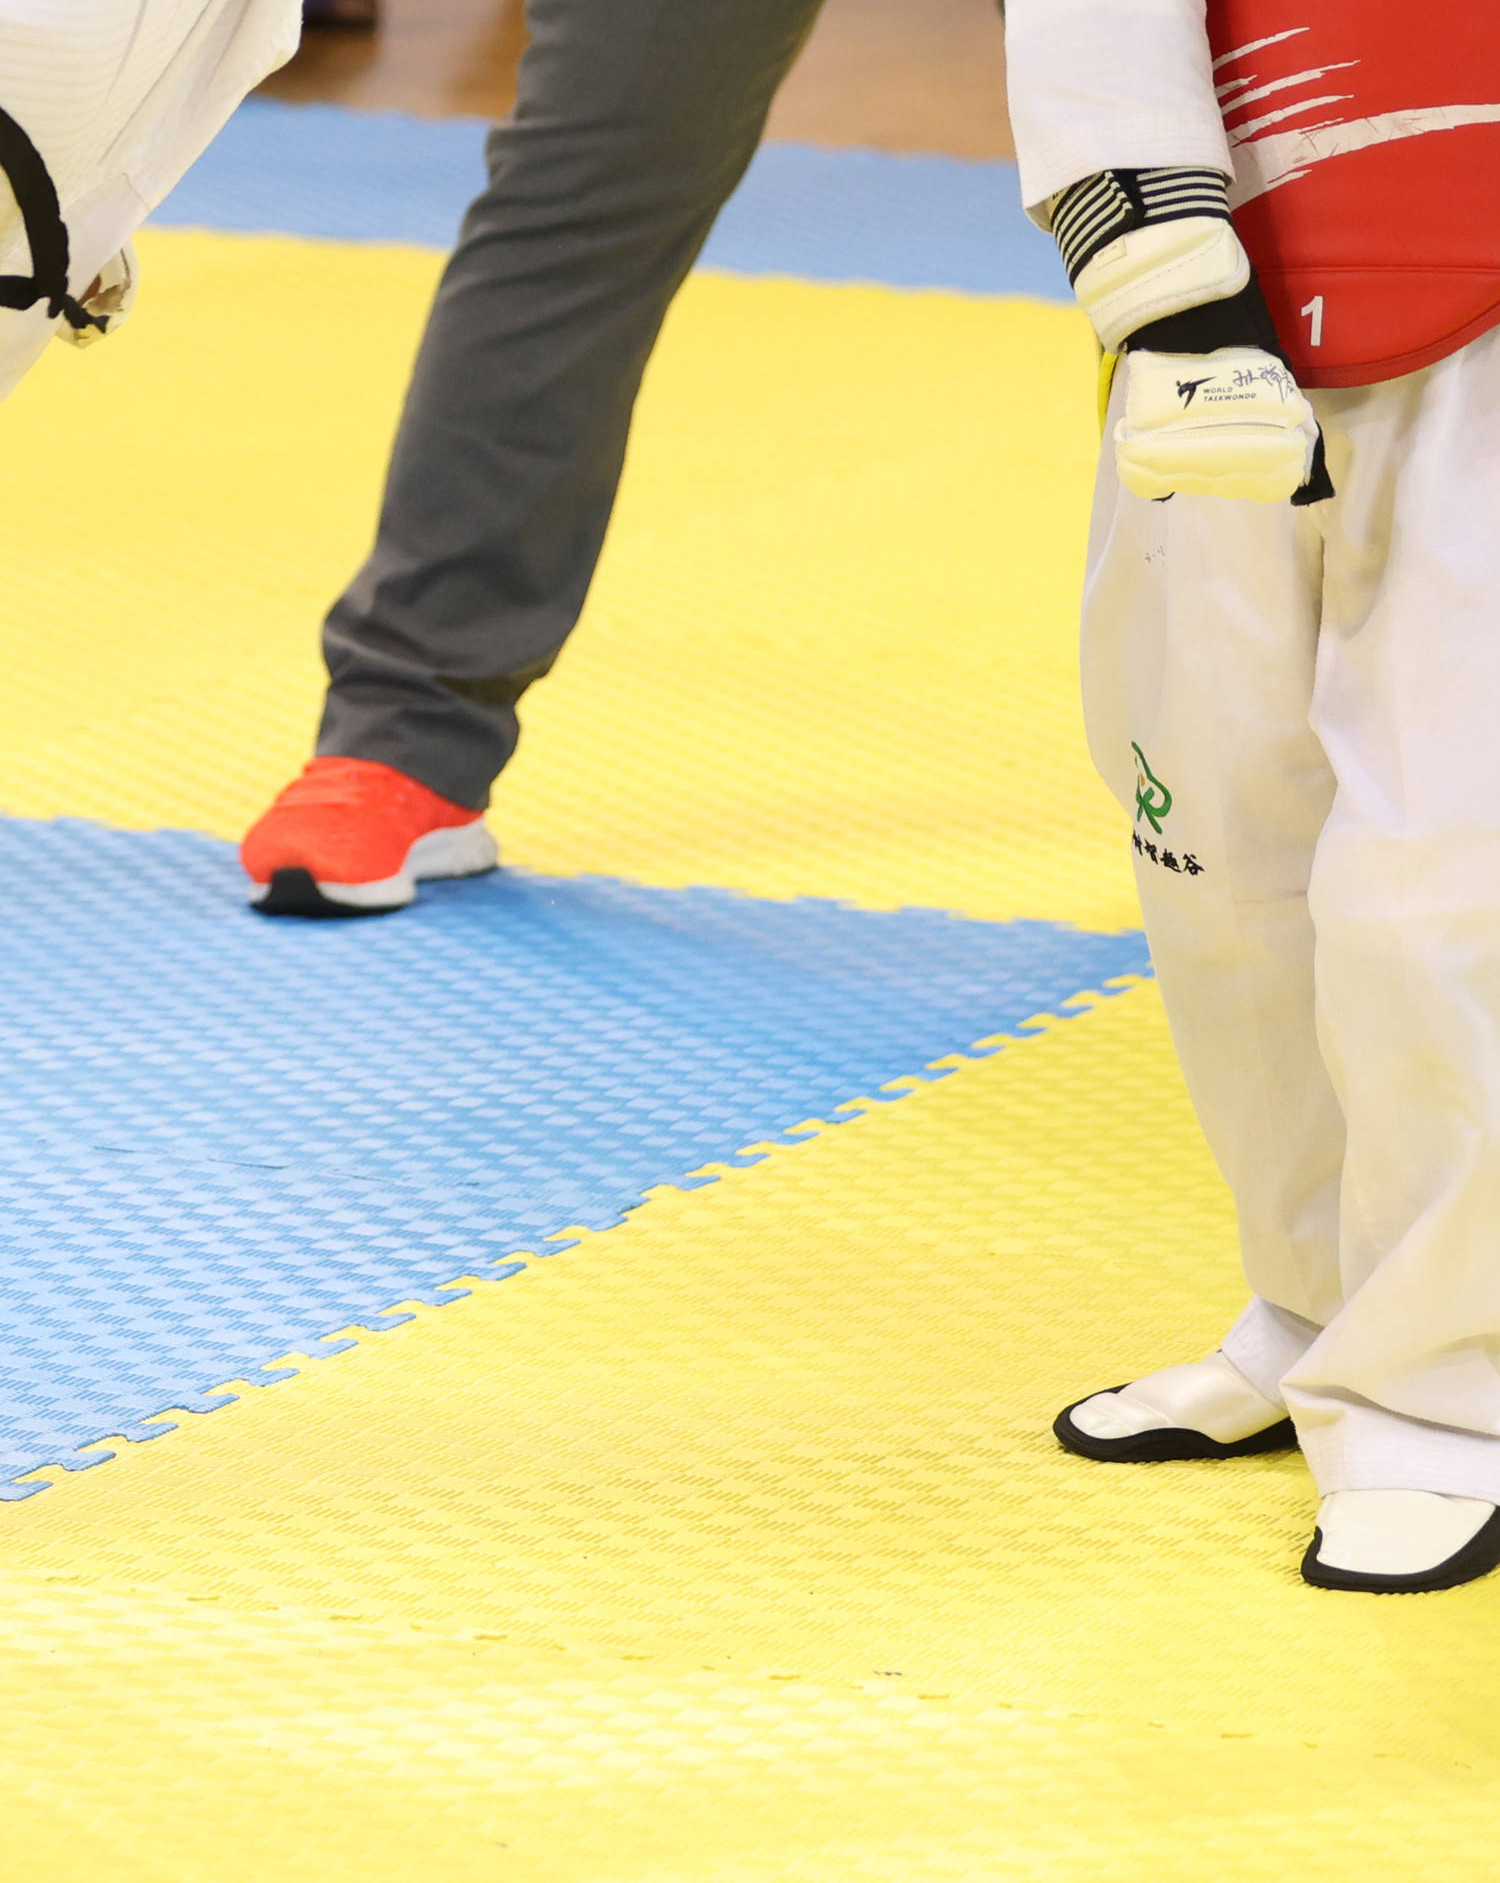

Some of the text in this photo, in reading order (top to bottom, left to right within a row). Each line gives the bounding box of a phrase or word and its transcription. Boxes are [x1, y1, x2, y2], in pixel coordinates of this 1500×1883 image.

[1301, 295, 1323, 347] 1
[1203, 386, 1233, 395] WORLD
[1203, 392, 1257, 402] TAEKWONDO
